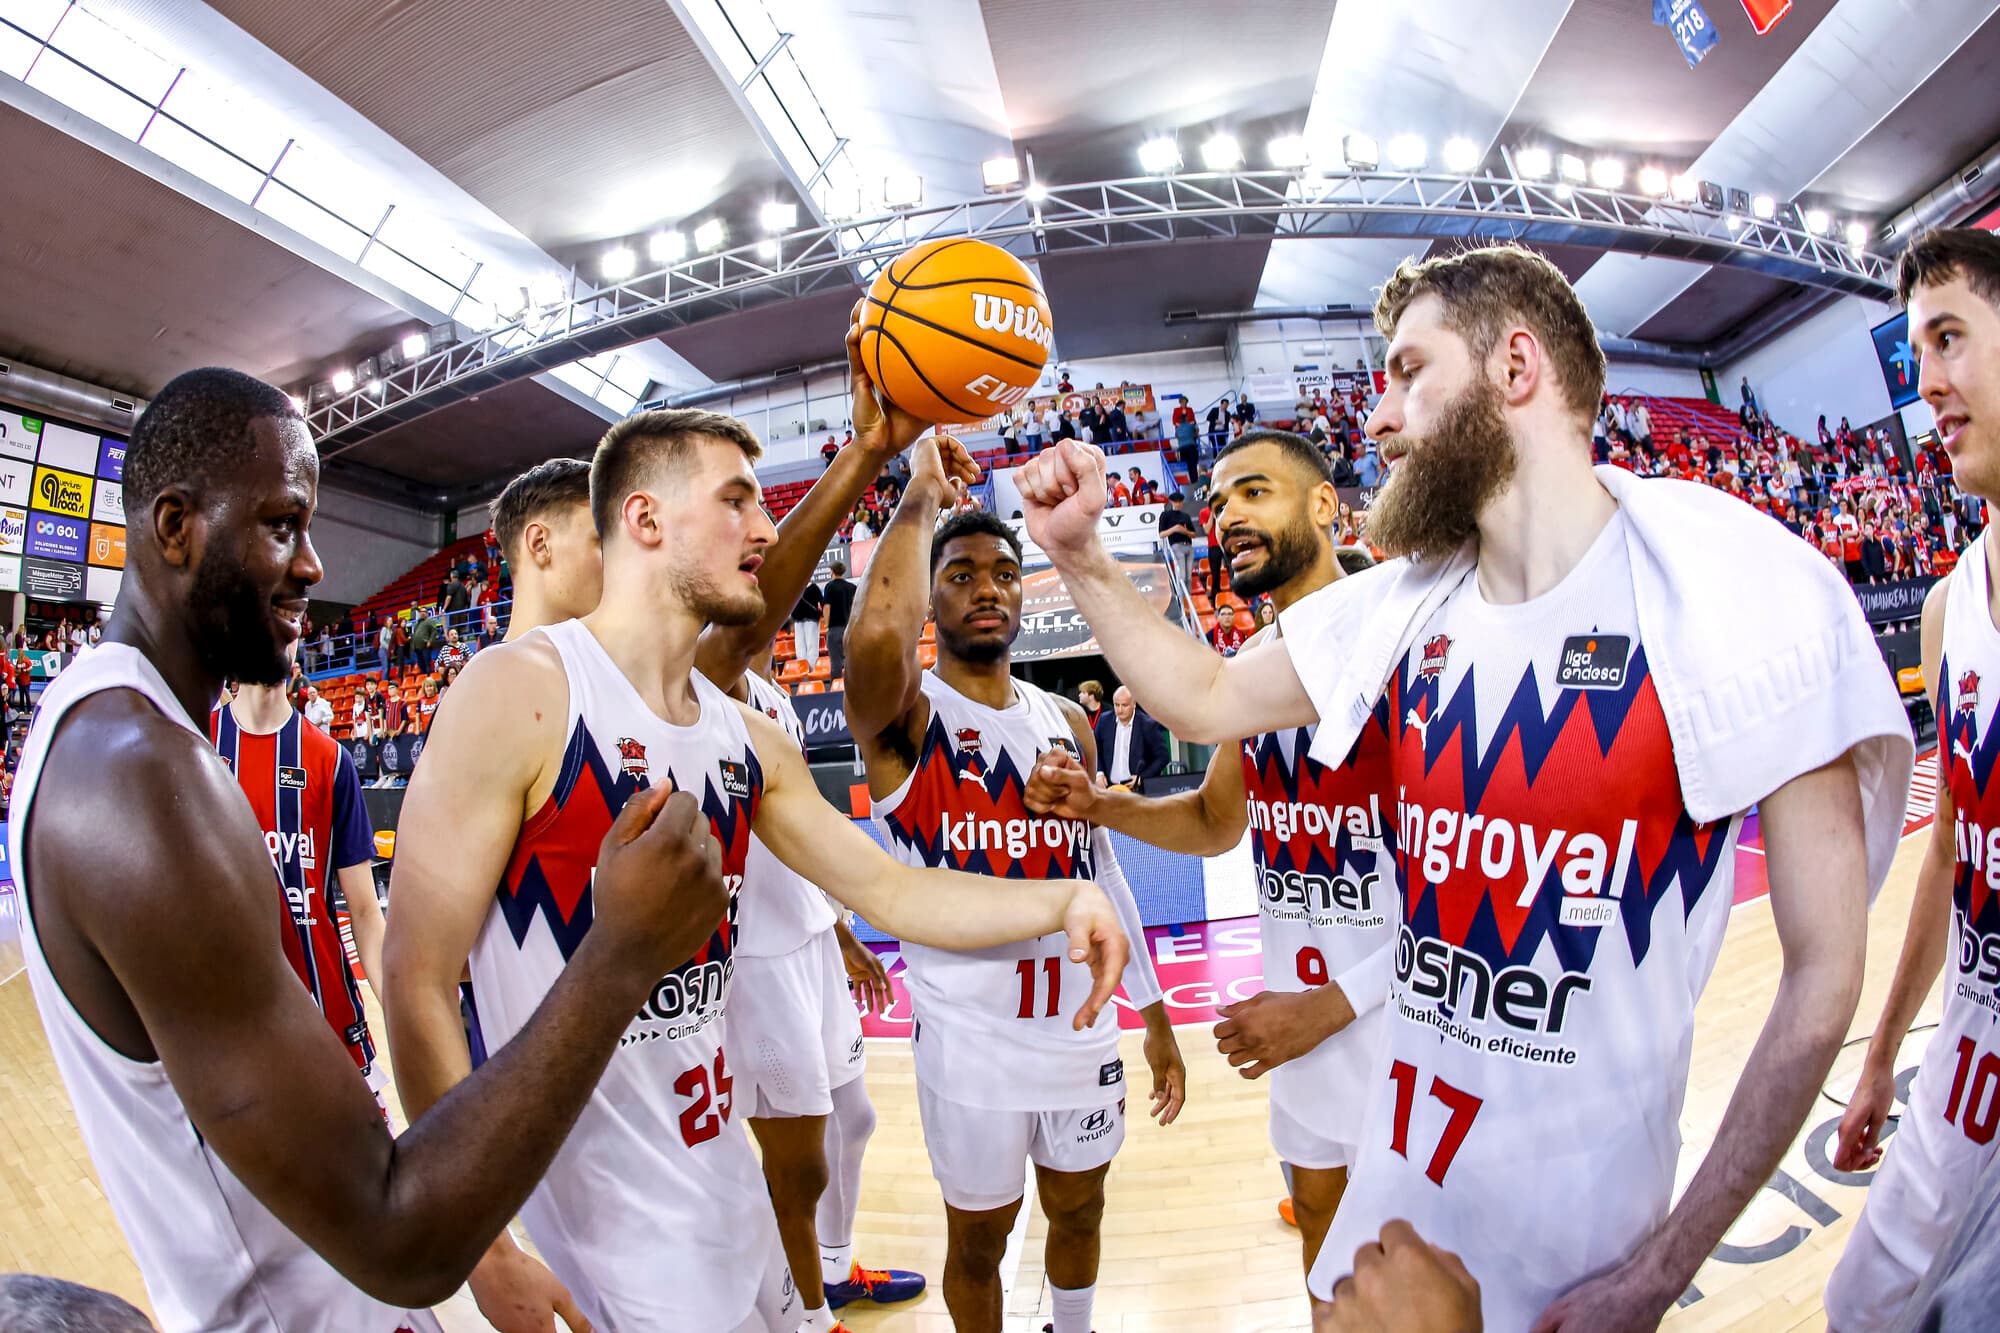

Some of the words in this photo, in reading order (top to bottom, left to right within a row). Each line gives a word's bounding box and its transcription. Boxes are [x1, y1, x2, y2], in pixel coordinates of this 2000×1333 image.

[1677, 8, 1705, 47] 218
[971, 292, 1053, 352] Wilso
[57, 525, 79, 539] GOL
[1562, 663, 1620, 682] endesa
[1565, 649, 1592, 667] liga
[263, 828, 316, 863] oyal
[941, 811, 1091, 859] kingroyal
[294, 916, 318, 926] ciente
[1336, 914, 1384, 928] eficiente
[1015, 957, 1061, 1019] 11
[1394, 926, 1592, 1034] osner
[1487, 1037, 1577, 1065] eficiente
[674, 1046, 734, 1149] 25
[1943, 1035, 2000, 1147] 10
[1388, 1059, 1484, 1188] 17
